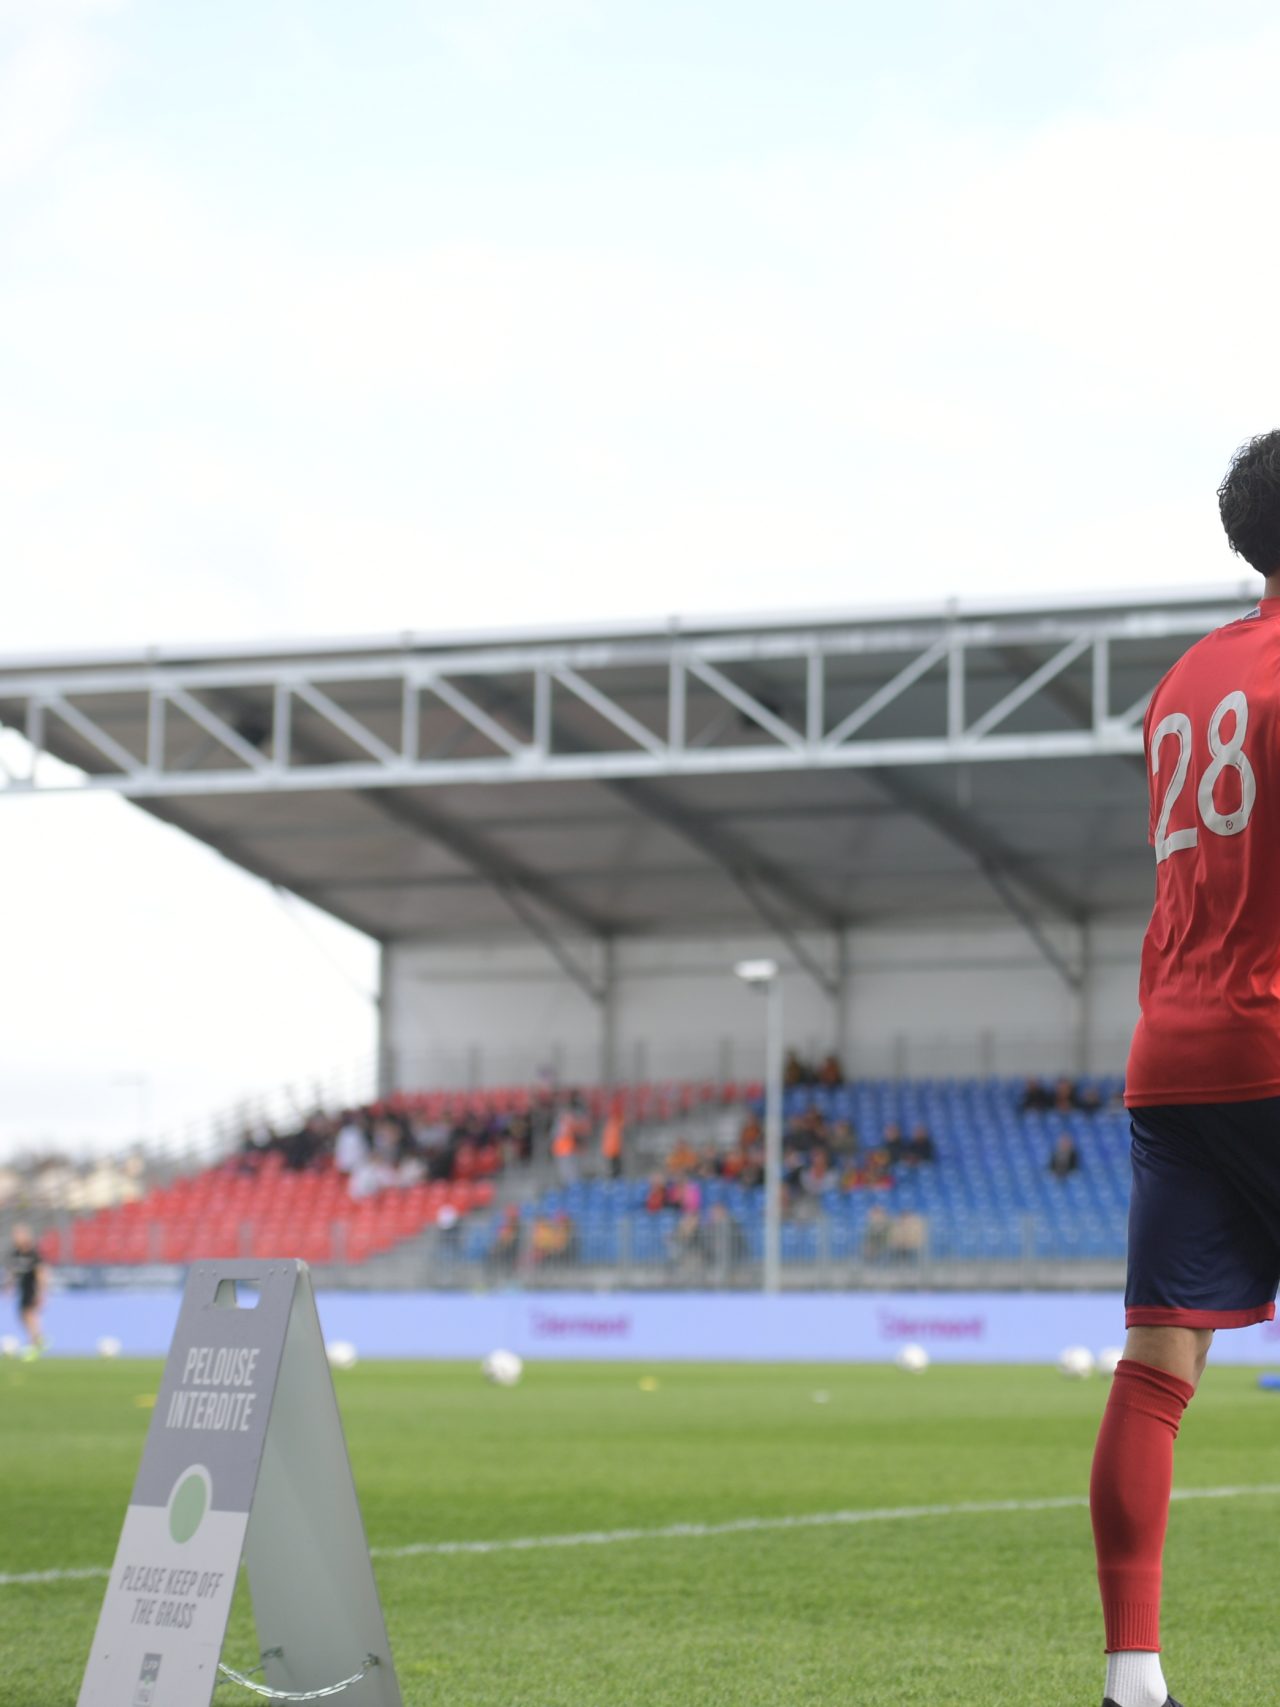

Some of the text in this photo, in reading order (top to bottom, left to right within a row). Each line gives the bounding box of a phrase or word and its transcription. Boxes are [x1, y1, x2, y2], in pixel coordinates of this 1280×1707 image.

[1151, 691, 1256, 864] 28
[182, 1347, 260, 1386] PELOUSE
[165, 1391, 256, 1431] INTERDITE
[119, 1565, 224, 1599] PLEASE KEEP OFF
[130, 1598, 197, 1630] THE GRASS
